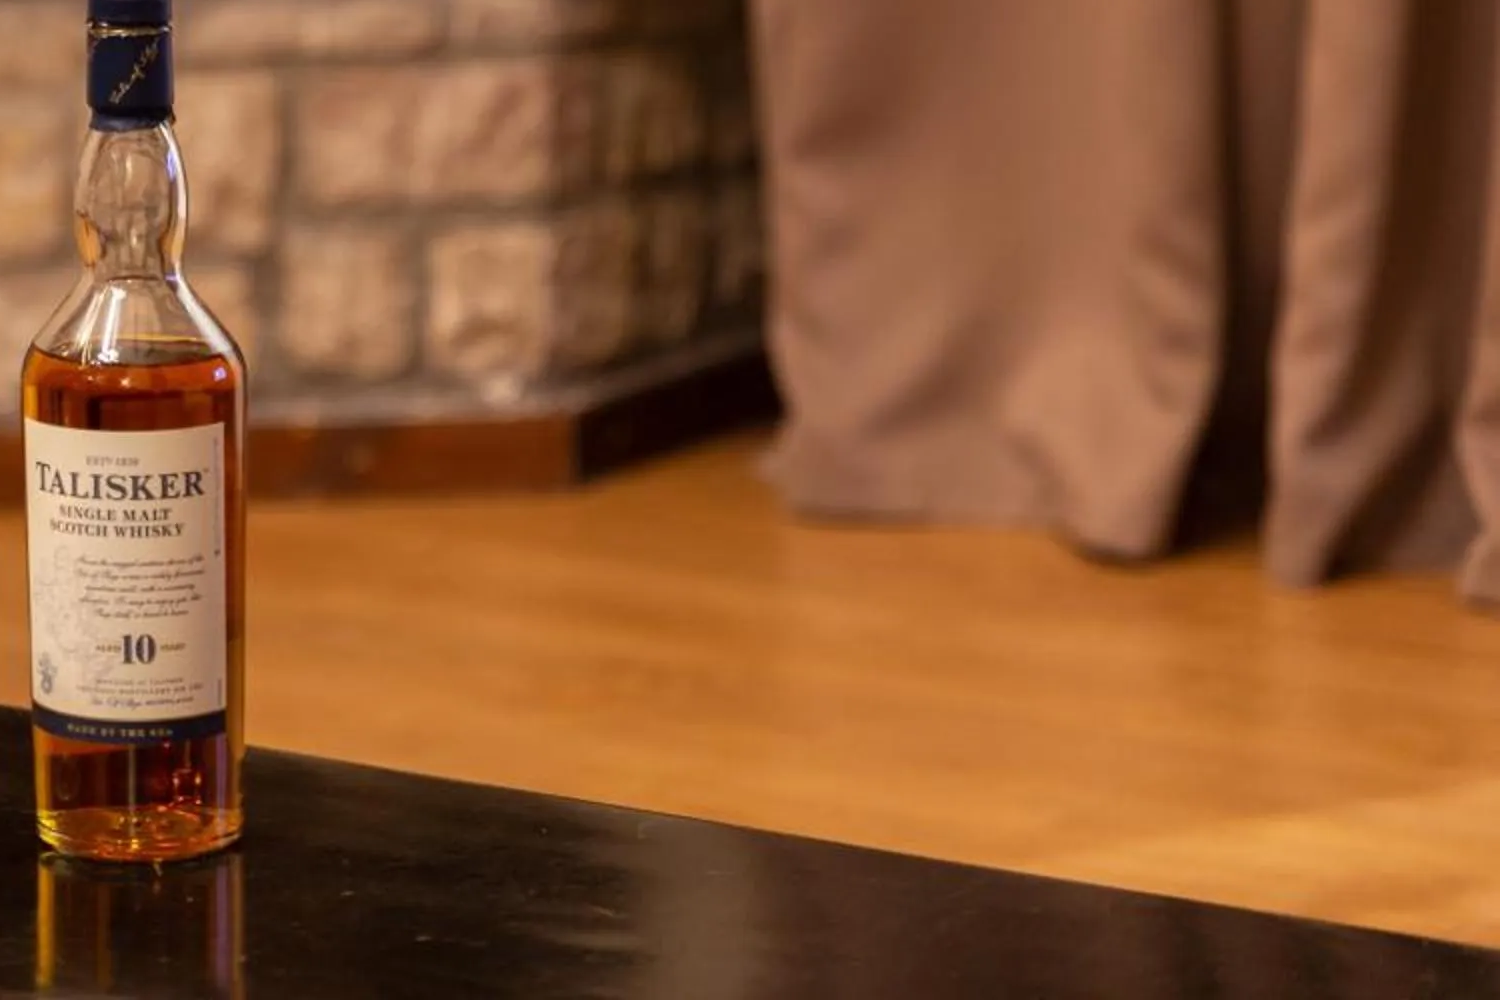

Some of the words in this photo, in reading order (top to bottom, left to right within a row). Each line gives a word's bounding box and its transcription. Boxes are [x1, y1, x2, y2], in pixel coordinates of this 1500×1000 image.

[35, 461, 204, 501] TALISKER
[59, 504, 117, 521] SINGLE
[123, 507, 172, 521] MALT
[50, 518, 108, 538] SCOTCH
[114, 522, 186, 539] WHISKY
[122, 633, 157, 665] 10
